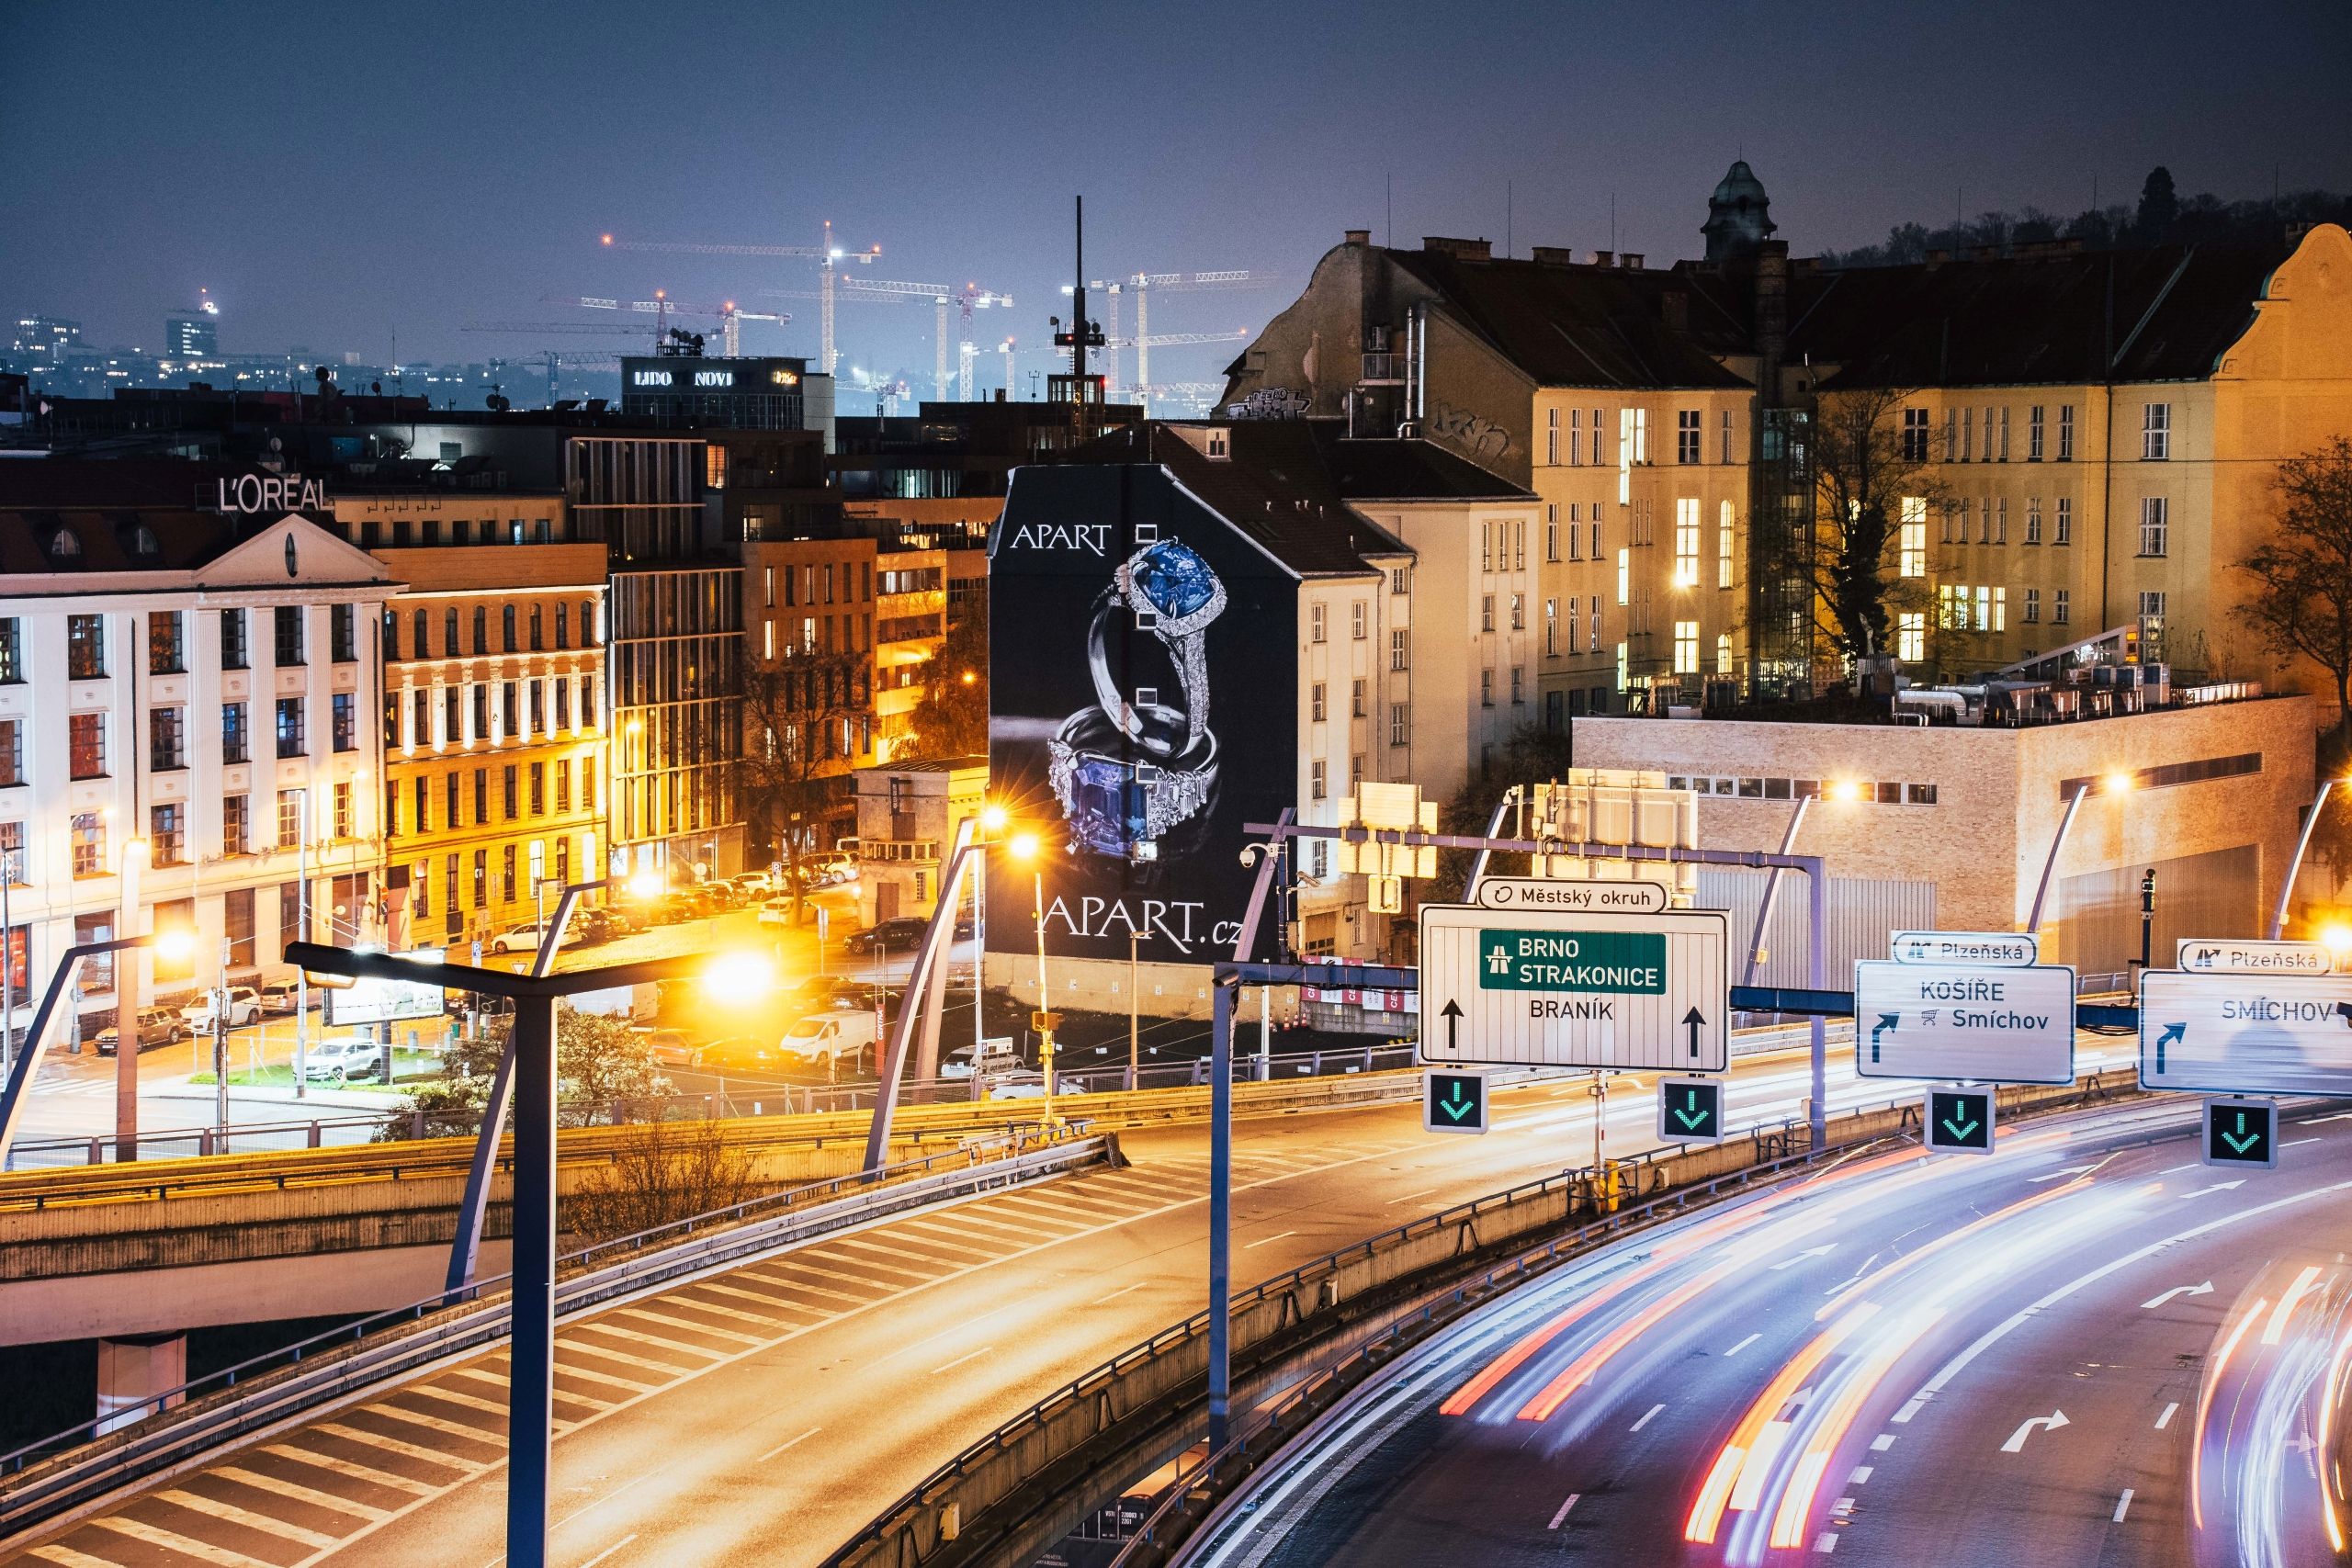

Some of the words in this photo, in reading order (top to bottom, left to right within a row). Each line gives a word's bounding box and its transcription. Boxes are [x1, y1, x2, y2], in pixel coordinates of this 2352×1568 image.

[220, 473, 335, 513] L'ORÉAL
[1009, 524, 1113, 557] APART
[1521, 888, 1592, 908] Městský
[1600, 890, 1651, 906] okruh
[1519, 938, 1579, 958] BRNO
[1941, 942, 2023, 960] Plzeňská
[2231, 952, 2318, 968] Plzeňská
[1520, 964, 1658, 987] STRAKONICE
[1921, 977, 2005, 1001] KOŠÍŘE
[1531, 998, 1613, 1021] BRANÍK
[1952, 1009, 2049, 1030] Smíchov
[2222, 997, 2333, 1021] SMÍCHOV
